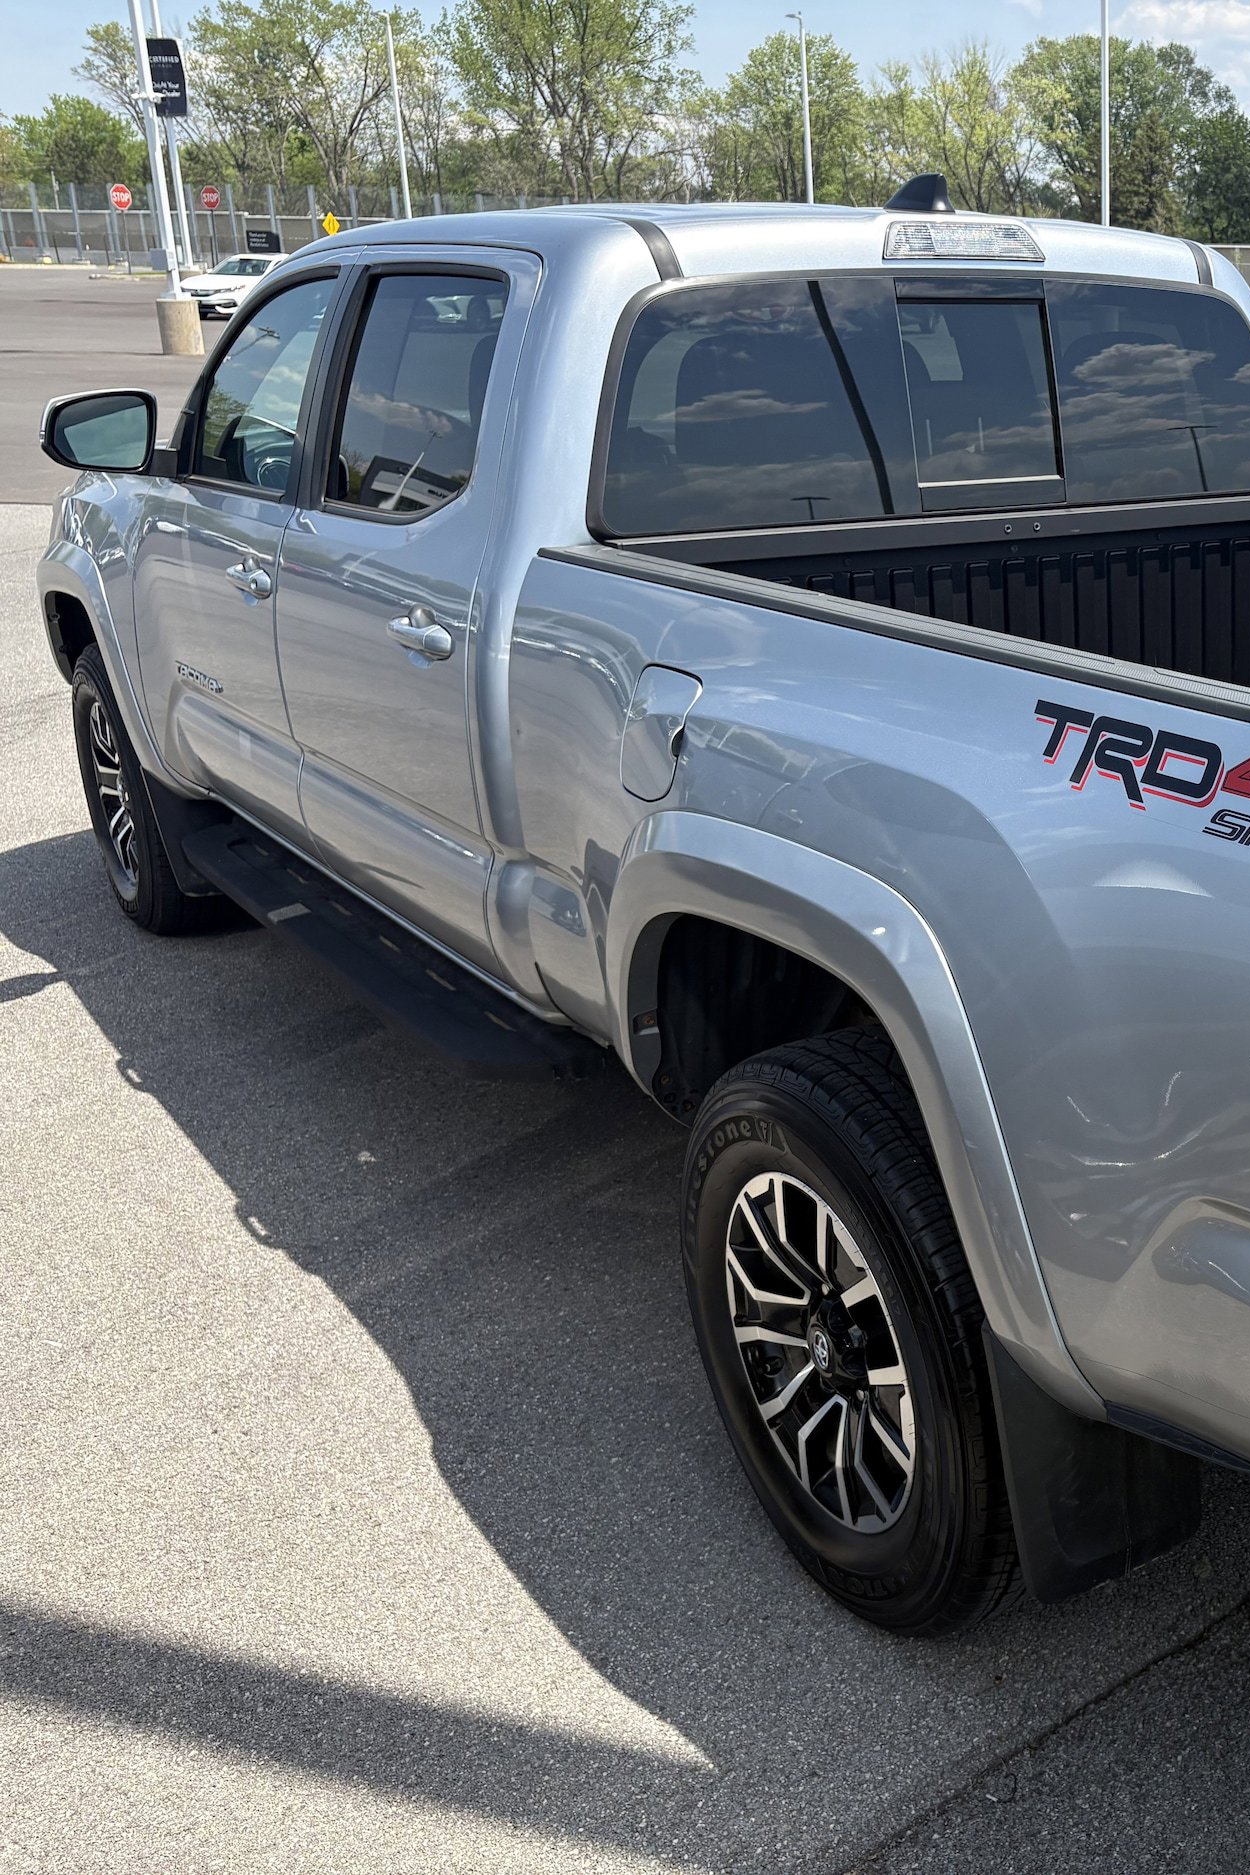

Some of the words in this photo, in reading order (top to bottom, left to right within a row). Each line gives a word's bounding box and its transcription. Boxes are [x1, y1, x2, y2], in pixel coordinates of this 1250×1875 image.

[112, 191, 129, 202] STOP
[202, 193, 219, 203] STOP
[174, 660, 223, 693] TACOMA
[1034, 699, 1224, 811] TRD
